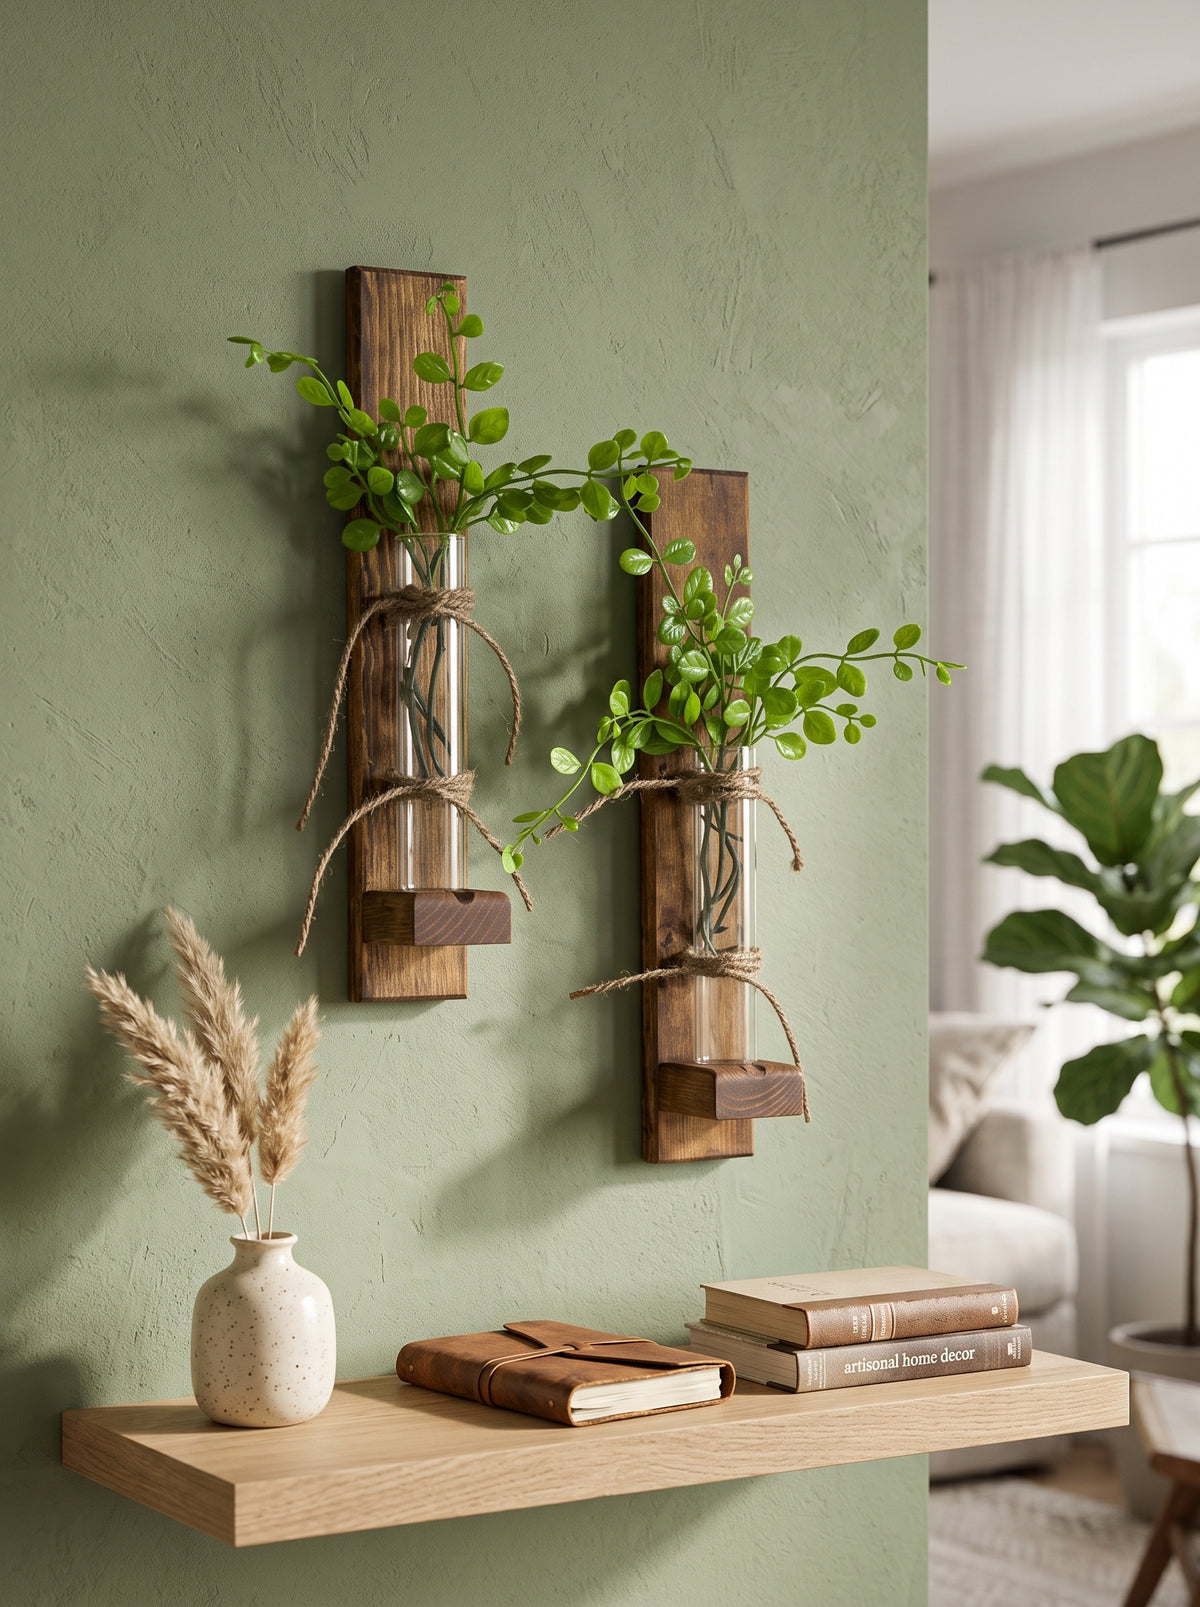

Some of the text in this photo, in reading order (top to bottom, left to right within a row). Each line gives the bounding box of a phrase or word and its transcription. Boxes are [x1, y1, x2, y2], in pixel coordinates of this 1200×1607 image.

[844, 1347, 976, 1374] artisonal home decor
